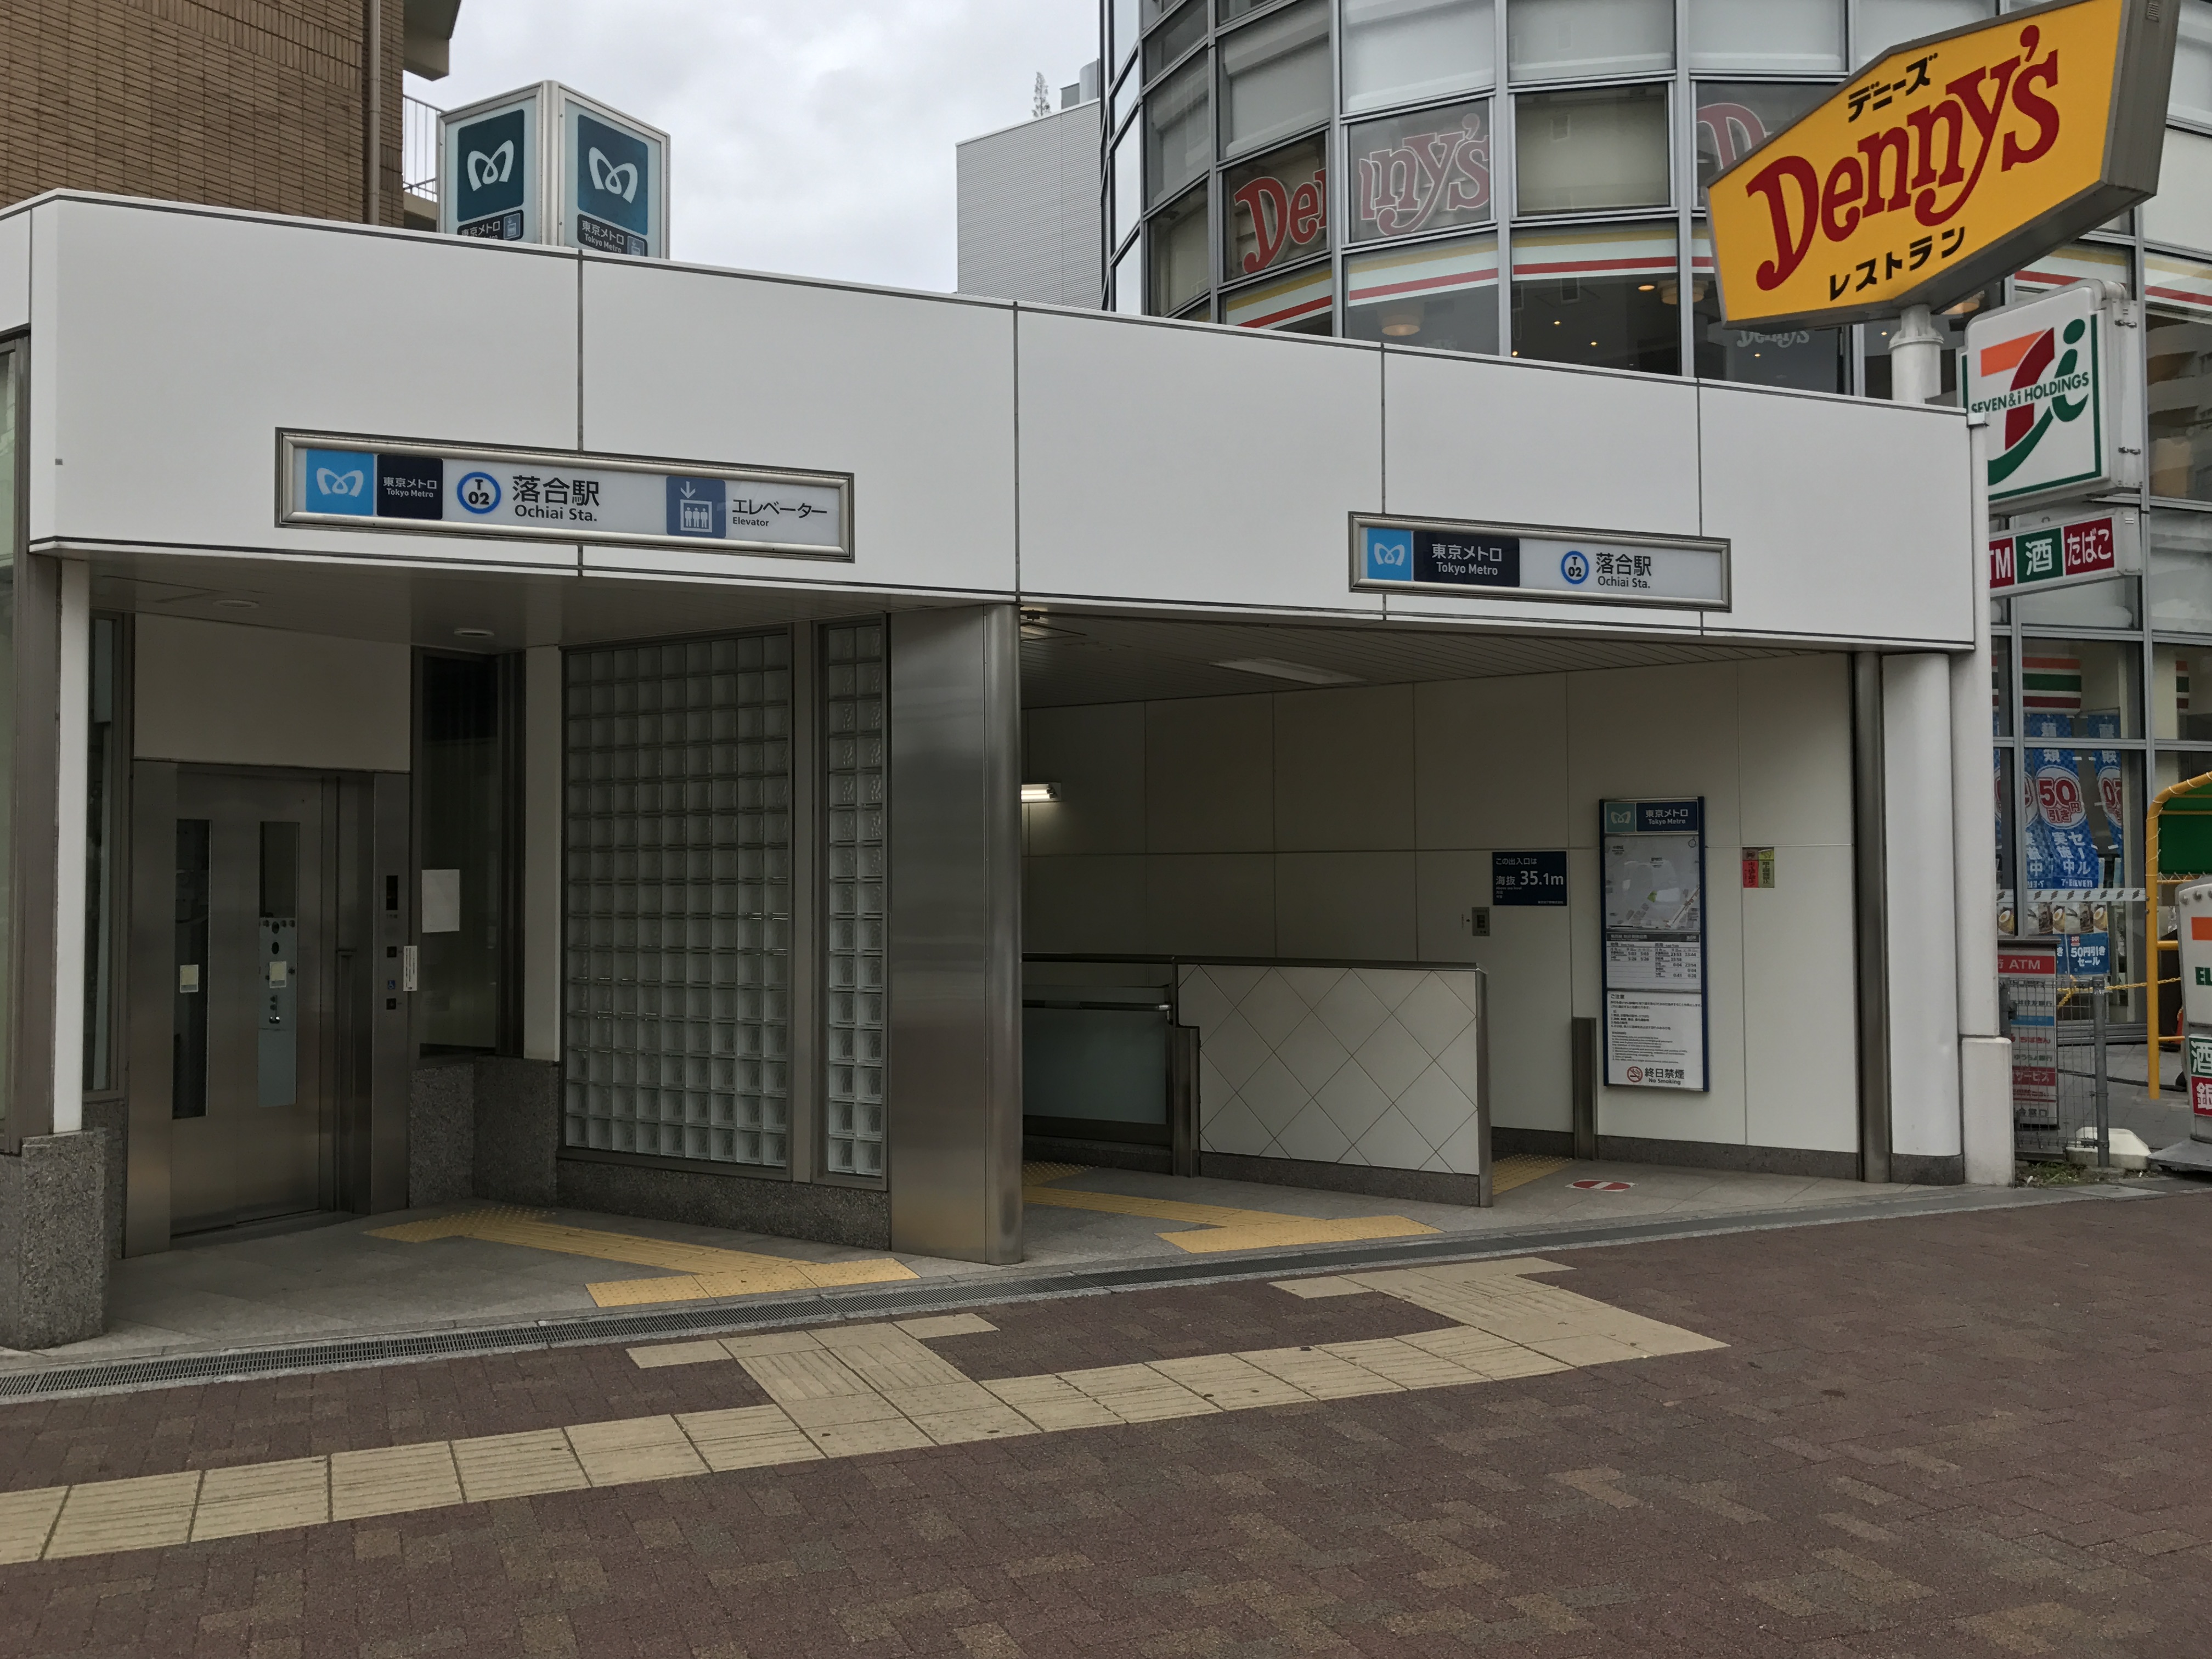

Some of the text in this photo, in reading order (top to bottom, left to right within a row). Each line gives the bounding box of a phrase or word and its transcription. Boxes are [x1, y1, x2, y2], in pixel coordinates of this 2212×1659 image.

[1848, 53, 1938, 122] デニーズ
[1746, 25, 2059, 291] Denny's
[582, 221, 624, 245] 東京メトロ
[584, 233, 622, 253] Tokyo Metro
[1830, 227, 1965, 301] レストラン
[2024, 371, 2089, 402] HOLDINGS
[383, 477, 437, 489] 東京メトロ
[475, 479, 483, 490] T
[386, 488, 433, 498] Tokyo Metro
[512, 475, 600, 506] 落合駅
[468, 492, 489, 505] 02
[515, 505, 597, 521] Ochiai Sta.
[732, 499, 827, 518] エレベーター
[733, 517, 769, 527] Elevator
[1432, 544, 1502, 562] 東京メトロ
[2067, 528, 2111, 566] たばこ
[1572, 556, 1578, 566] T
[2025, 538, 2052, 575] 酒
[1436, 562, 1498, 575] Tokyo Metro
[1596, 552, 1651, 576] 落合駅
[1568, 567, 1582, 577] 02
[1598, 576, 1651, 589] Ochiai Sta.
[1646, 809, 1688, 817] 東京メトロ
[1496, 870, 1564, 885] 海抜 35.1m
[2070, 946, 2106, 957] 50円引き
[2008, 959, 2040, 970] ATM
[2078, 957, 2100, 967] セール
[1645, 1068, 1684, 1079] 終日禁煙
